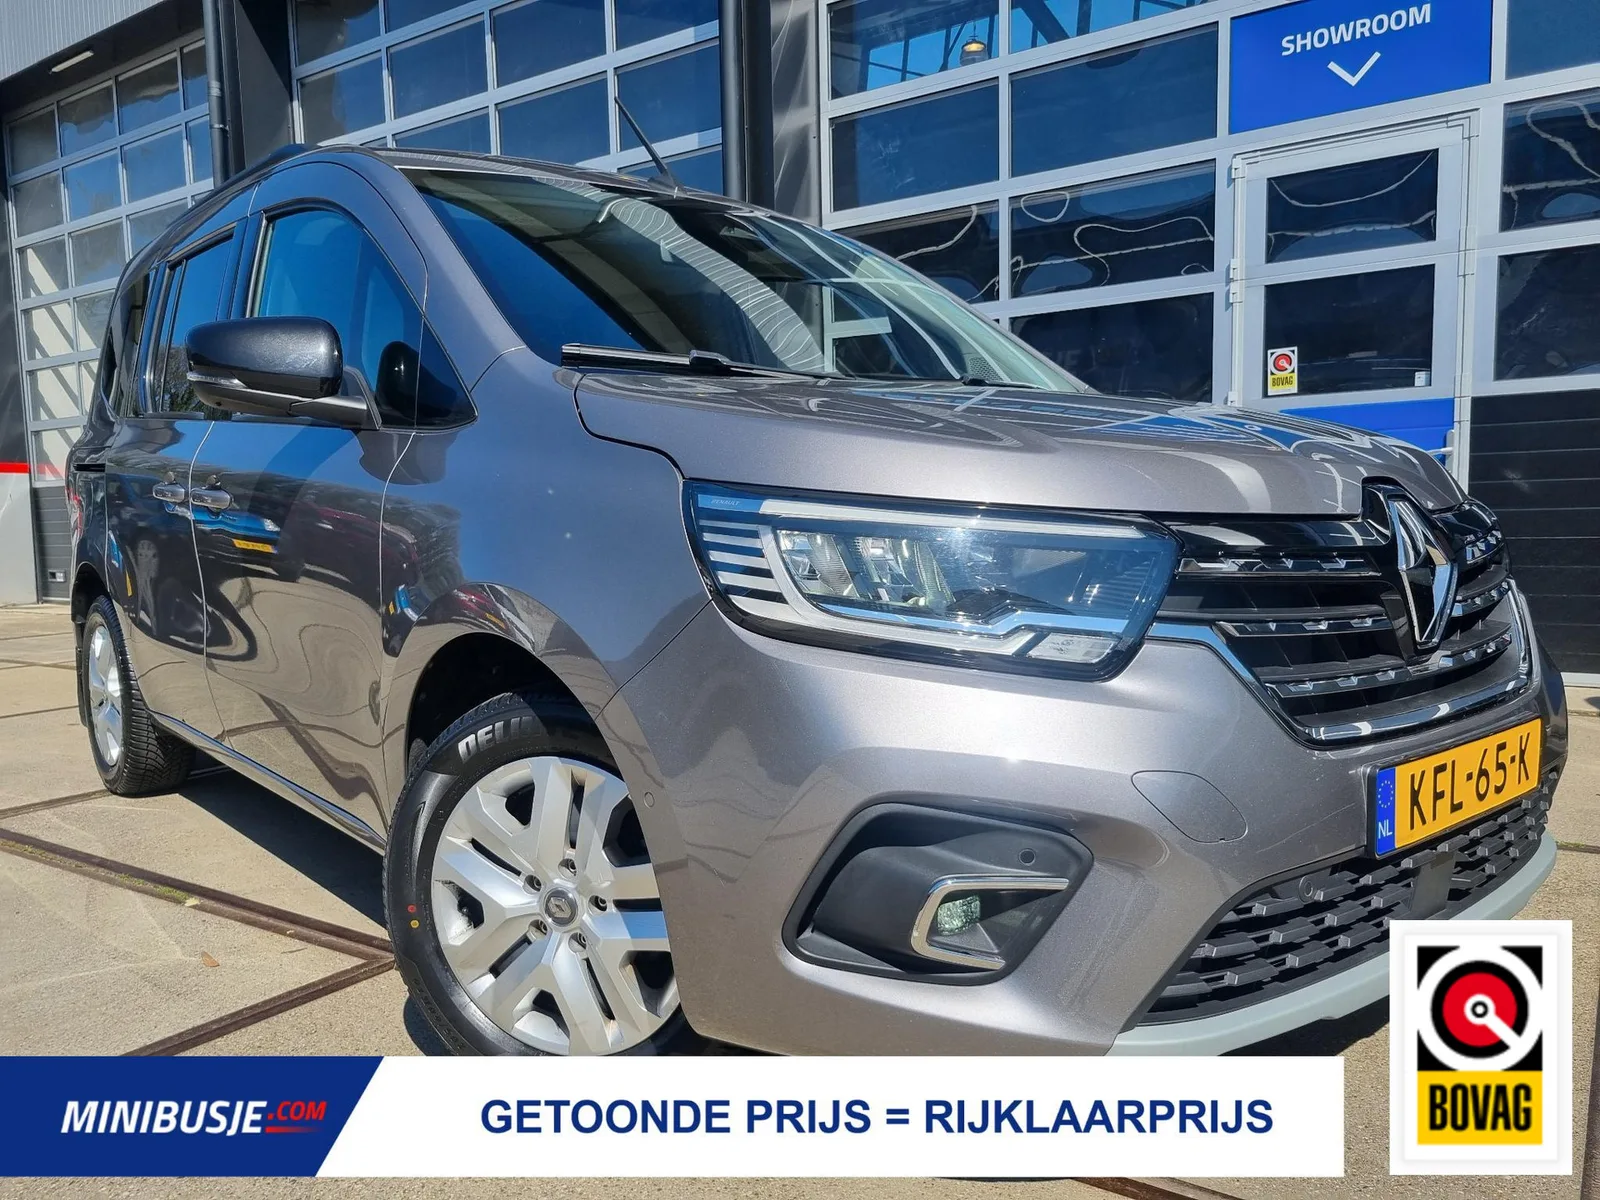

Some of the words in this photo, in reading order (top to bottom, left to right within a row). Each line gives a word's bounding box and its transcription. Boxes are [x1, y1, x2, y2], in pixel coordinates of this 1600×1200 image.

[1281, 3, 1431, 56] SHOWROOM
[1271, 375, 1294, 387] BOVAG
[1409, 732, 1531, 831] KFL-65-K
[1377, 819, 1393, 839] NL
